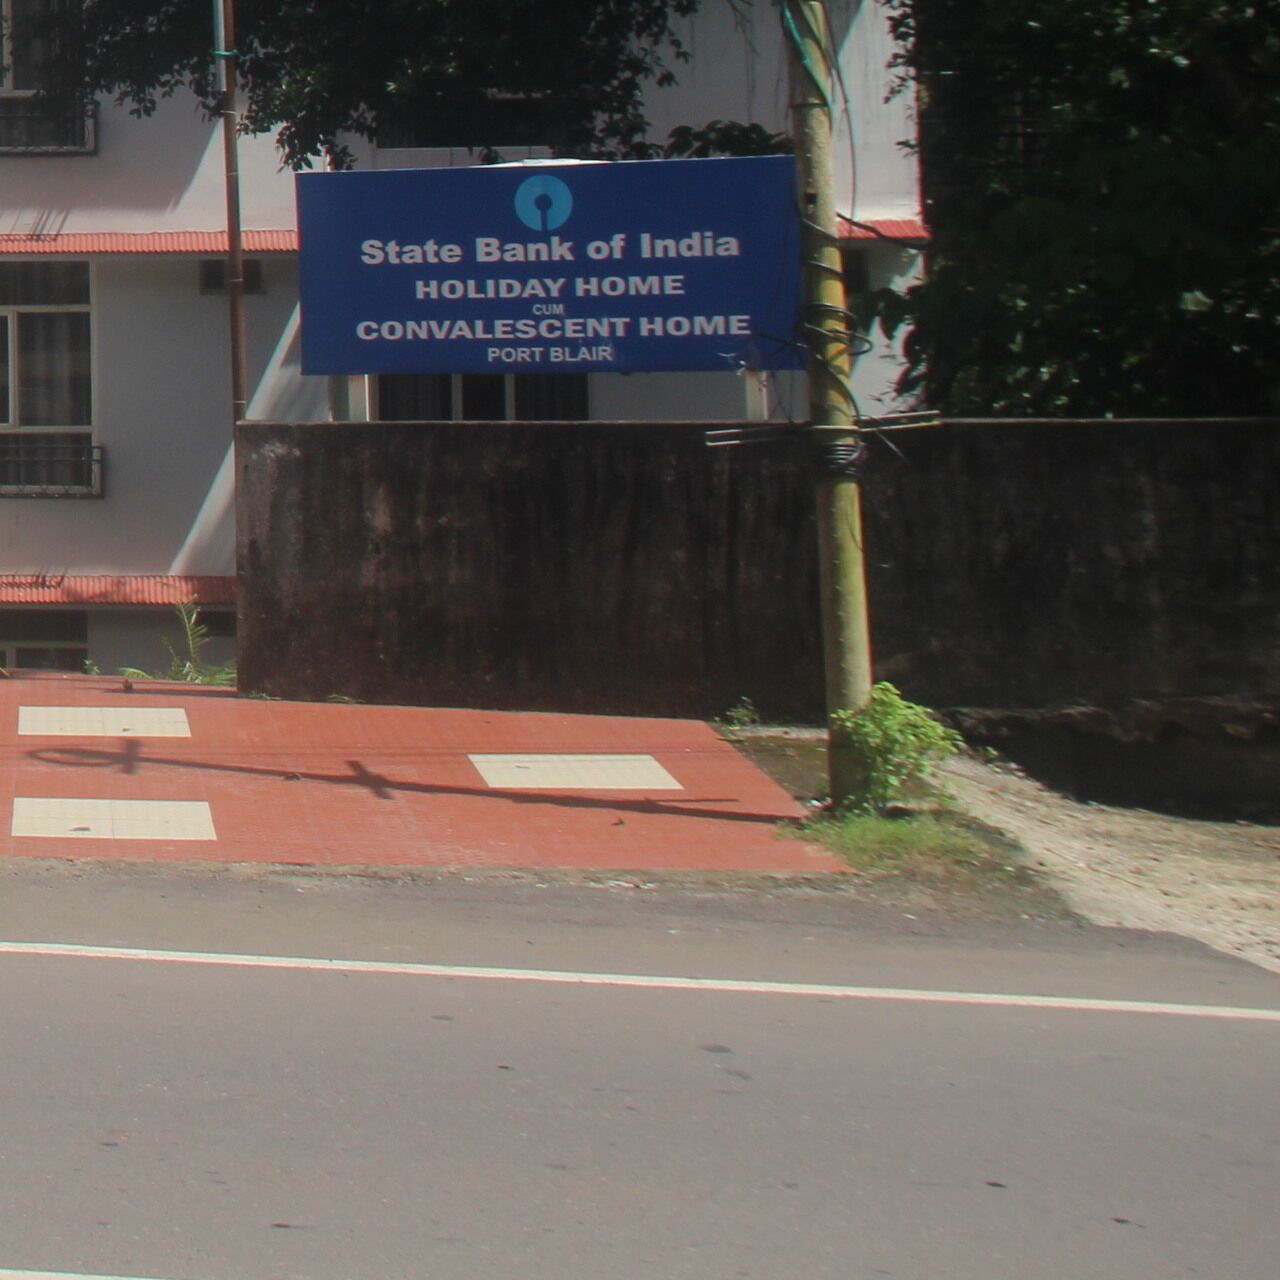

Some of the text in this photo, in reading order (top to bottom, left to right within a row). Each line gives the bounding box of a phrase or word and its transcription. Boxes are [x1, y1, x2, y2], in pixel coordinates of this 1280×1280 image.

[360, 231, 740, 265] State Bank of India
[415, 275, 686, 300] HOLIDAY HOME
[532, 303, 565, 316] CUM
[356, 314, 752, 341] CONVALESCENT HOME
[487, 345, 614, 363] PORT BLAIR
